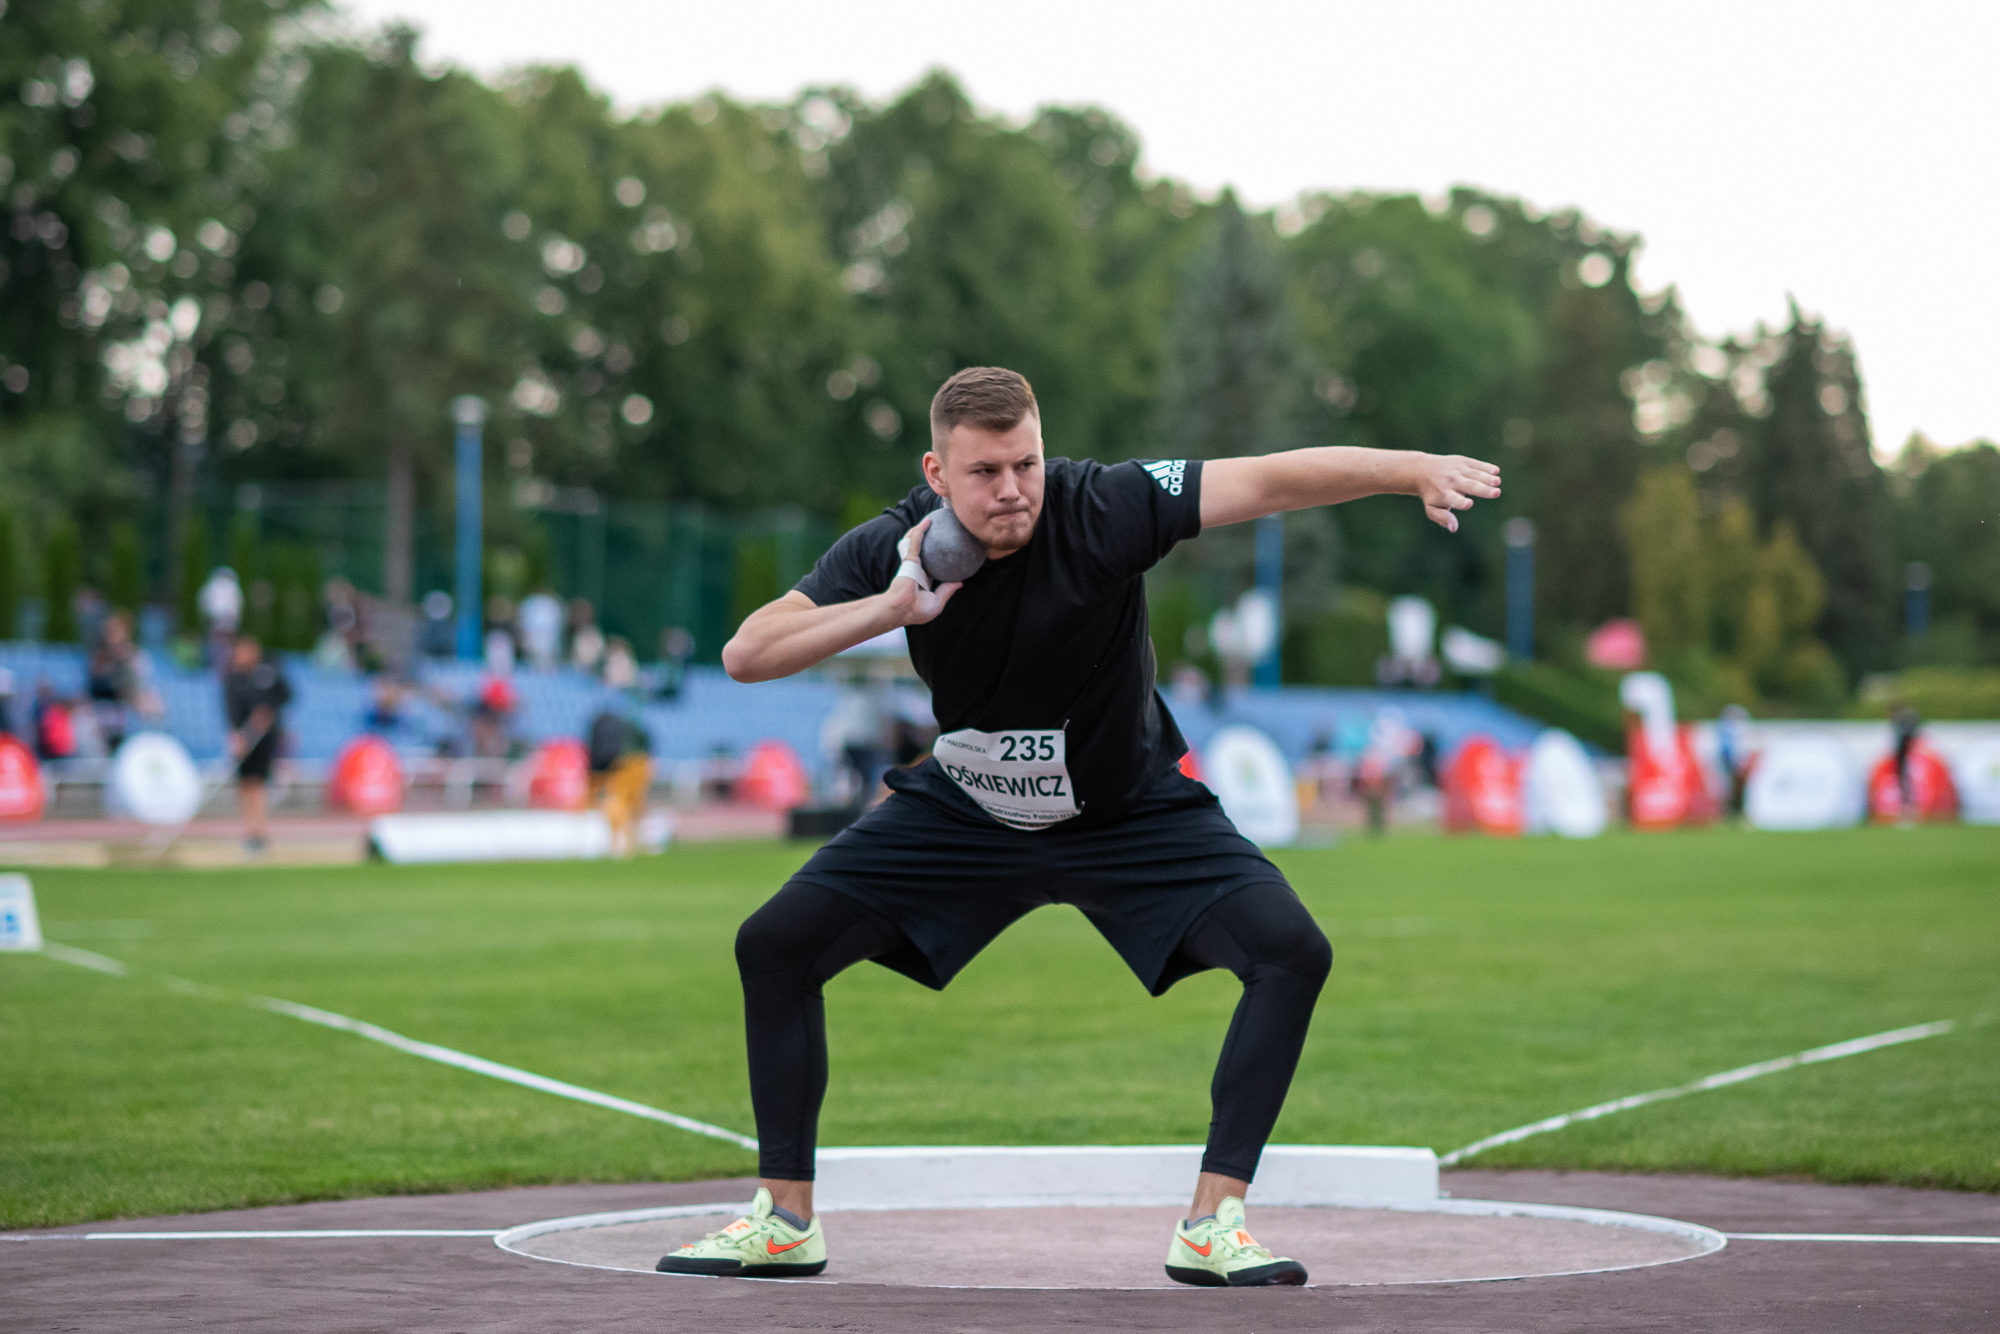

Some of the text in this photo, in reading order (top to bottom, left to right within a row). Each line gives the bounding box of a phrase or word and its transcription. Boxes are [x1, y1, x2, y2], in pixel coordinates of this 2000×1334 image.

[1169, 459, 1187, 496] adida
[1000, 735, 1055, 762] 235
[946, 764, 1066, 798] OŚKIEWICZ
